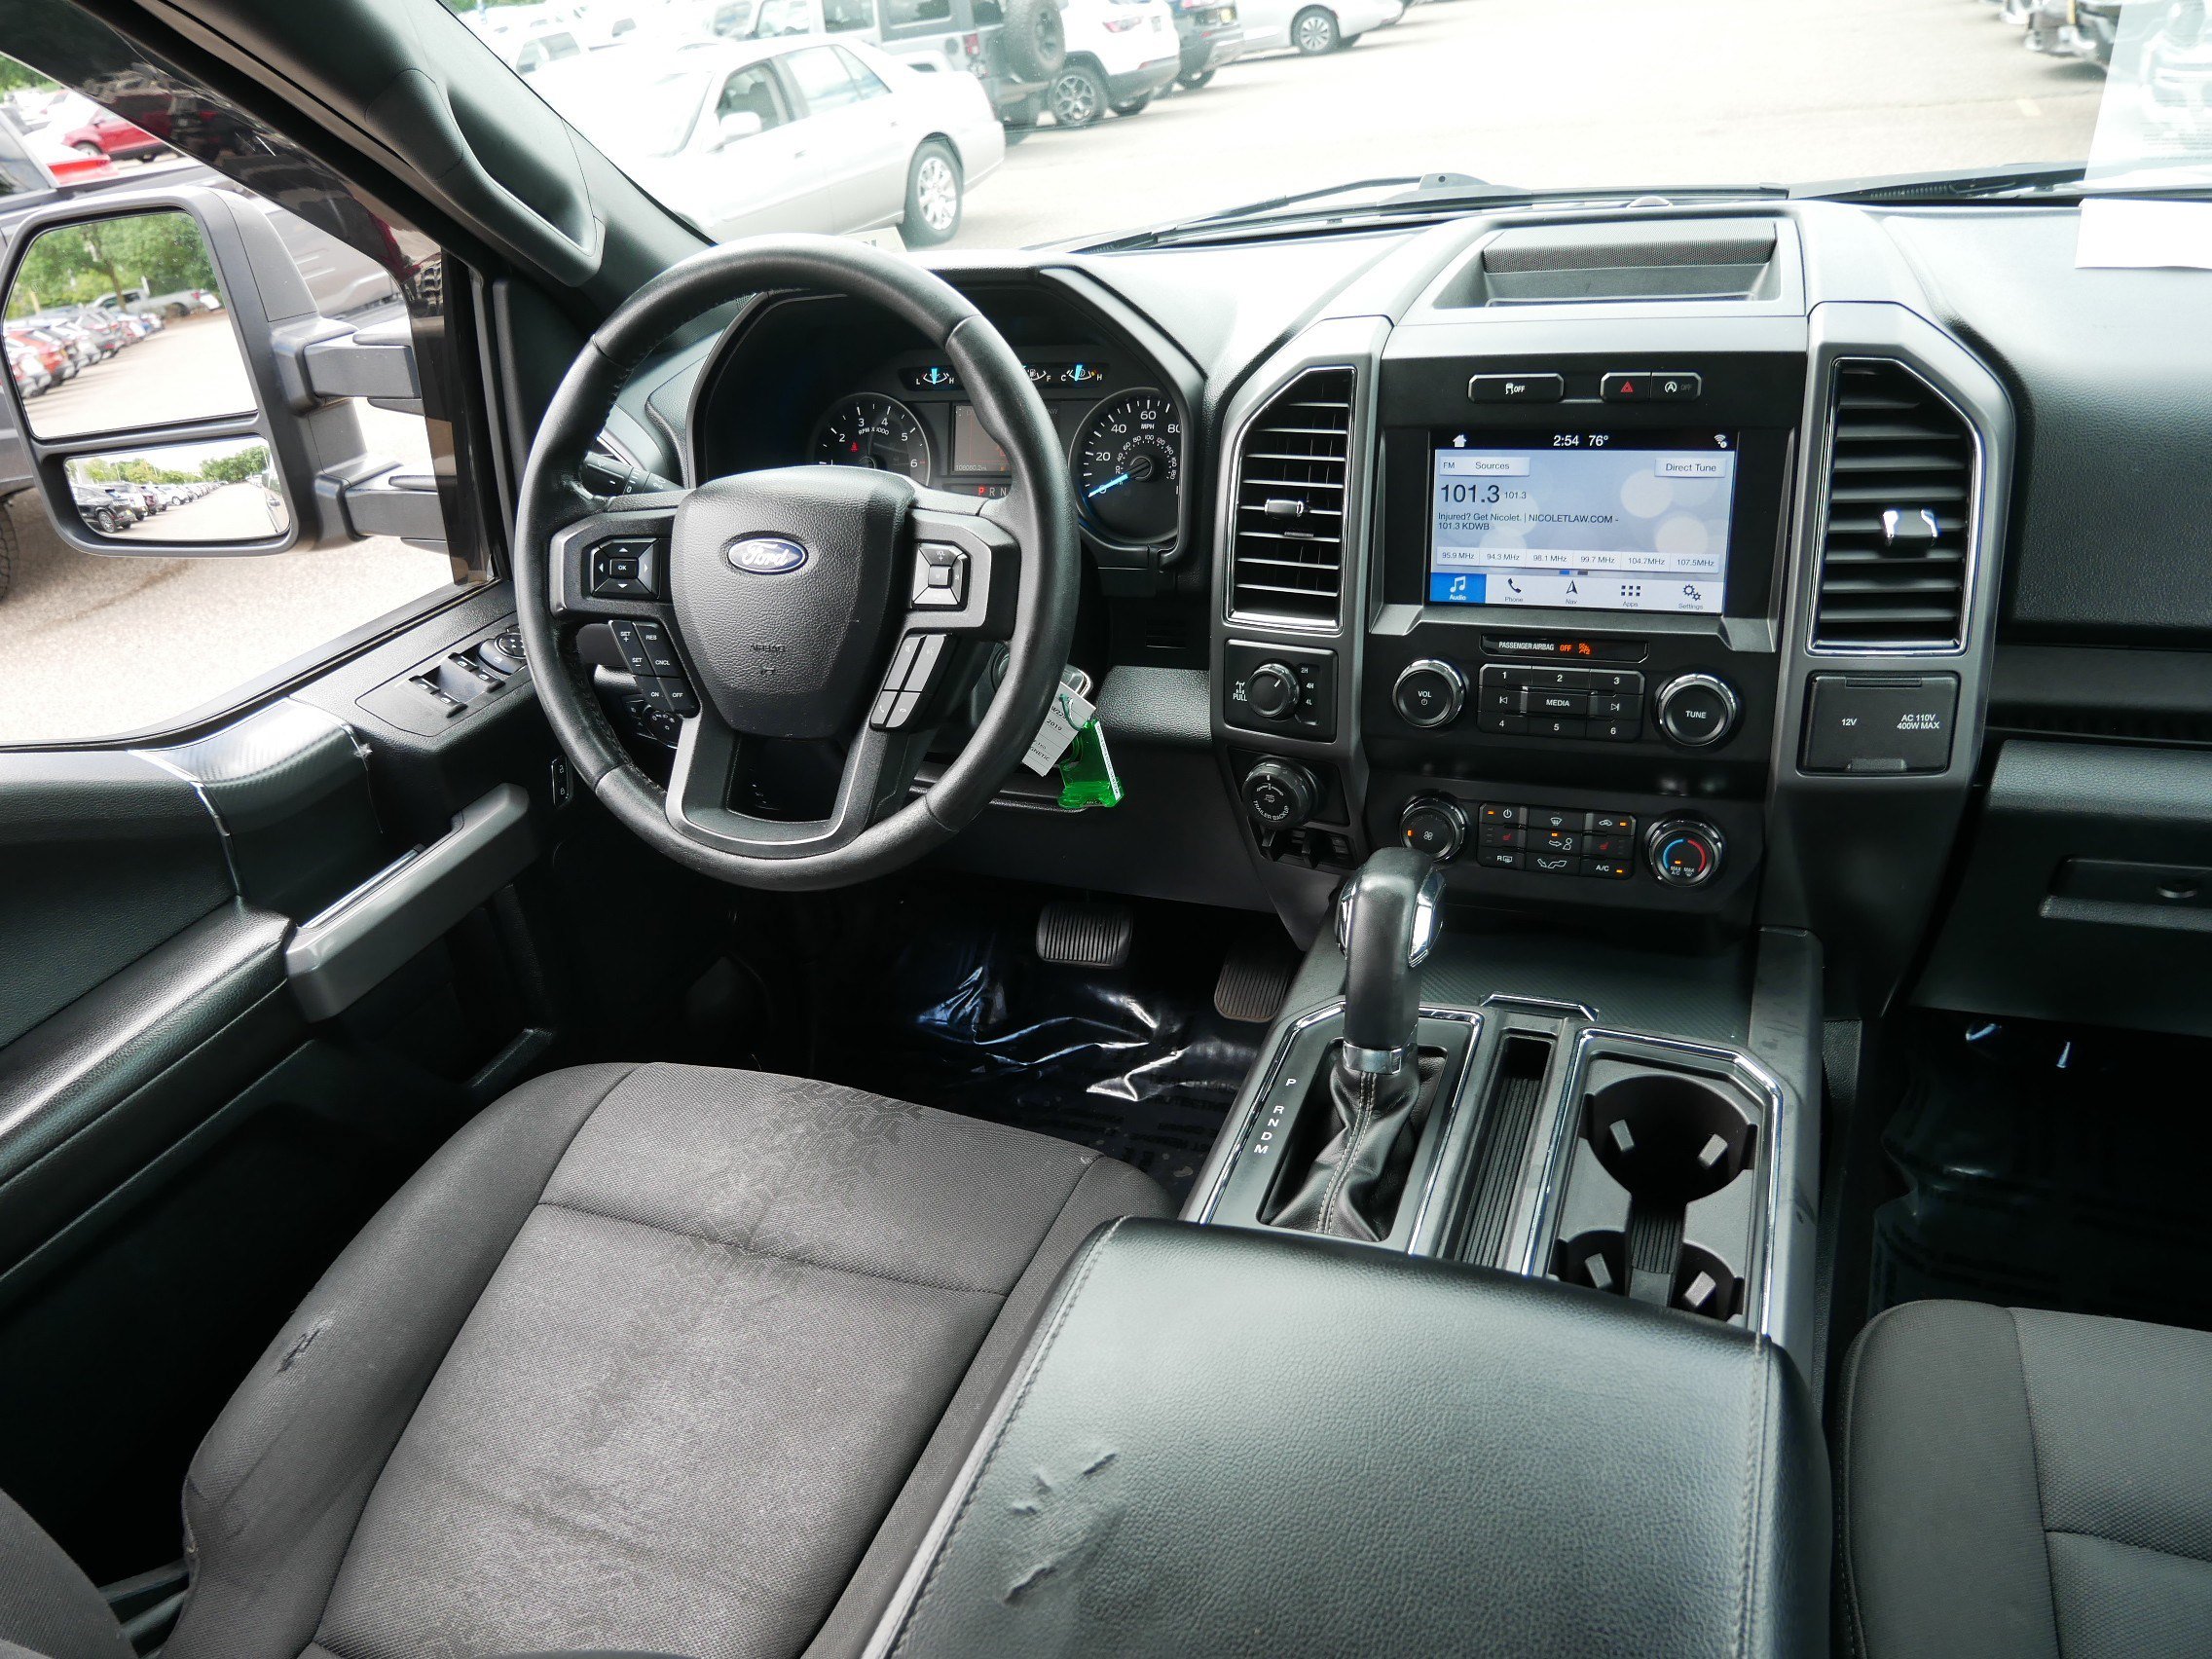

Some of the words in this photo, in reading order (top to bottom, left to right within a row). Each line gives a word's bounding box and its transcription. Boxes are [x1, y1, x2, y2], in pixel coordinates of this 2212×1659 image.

[1513, 385, 1526, 393] OFF
[1140, 410, 1157, 421] 60
[858, 418, 865, 427] 3
[881, 418, 888, 426] 4
[858, 426, 870, 436] RPM
[875, 426, 890, 436] 1000
[1110, 424, 1127, 433] 40
[838, 433, 846, 442] 2
[901, 432, 908, 441] 5
[1553, 435, 1579, 447] 2:54
[1588, 435, 1609, 447] 76°
[1123, 441, 1131, 451] 60
[1095, 452, 1111, 461] 20
[1117, 453, 1124, 462] 40
[910, 459, 918, 467] 6
[1475, 461, 1510, 470] Sources
[1665, 462, 1692, 472] Direct
[1695, 463, 1716, 472] Tune
[978, 487, 985, 496] P
[989, 487, 995, 496] R
[1000, 487, 1007, 496] N
[1440, 484, 1500, 503] 101.3
[1504, 491, 1527, 499] 101.3
[1438, 512, 1471, 522] Injured?
[1490, 513, 1522, 522] Nicolet.
[1529, 514, 1613, 524] NICOLETLAW.COM
[1438, 522, 1460, 531] 101.3
[741, 541, 791, 567] Ford
[1678, 603, 1704, 611] Settings
[1498, 641, 1532, 650] PASSENGER
[1532, 642, 1555, 651] AIRBAG
[1502, 671, 1507, 680] 1
[1557, 674, 1564, 682] 2
[1613, 677, 1620, 685] 3
[1233, 693, 1248, 702] PULL
[1545, 698, 1570, 707] MEDIA
[1685, 711, 1707, 719] TUNE
[1900, 714, 1914, 722] AC
[1915, 714, 1936, 722] 110V
[1046, 719, 1063, 731] 2019
[1841, 718, 1858, 726] 12V
[1897, 721, 1919, 730] 400W
[1029, 746, 1051, 761] GNETIC
[1252, 799, 1272, 821] TRAILER
[1272, 804, 1290, 821] BACKUP
[1285, 1078, 1297, 1087] P
[1272, 1105, 1285, 1115] R
[1267, 1118, 1280, 1127] N
[1260, 1131, 1272, 1141] D
[1253, 1144, 1270, 1155] M
